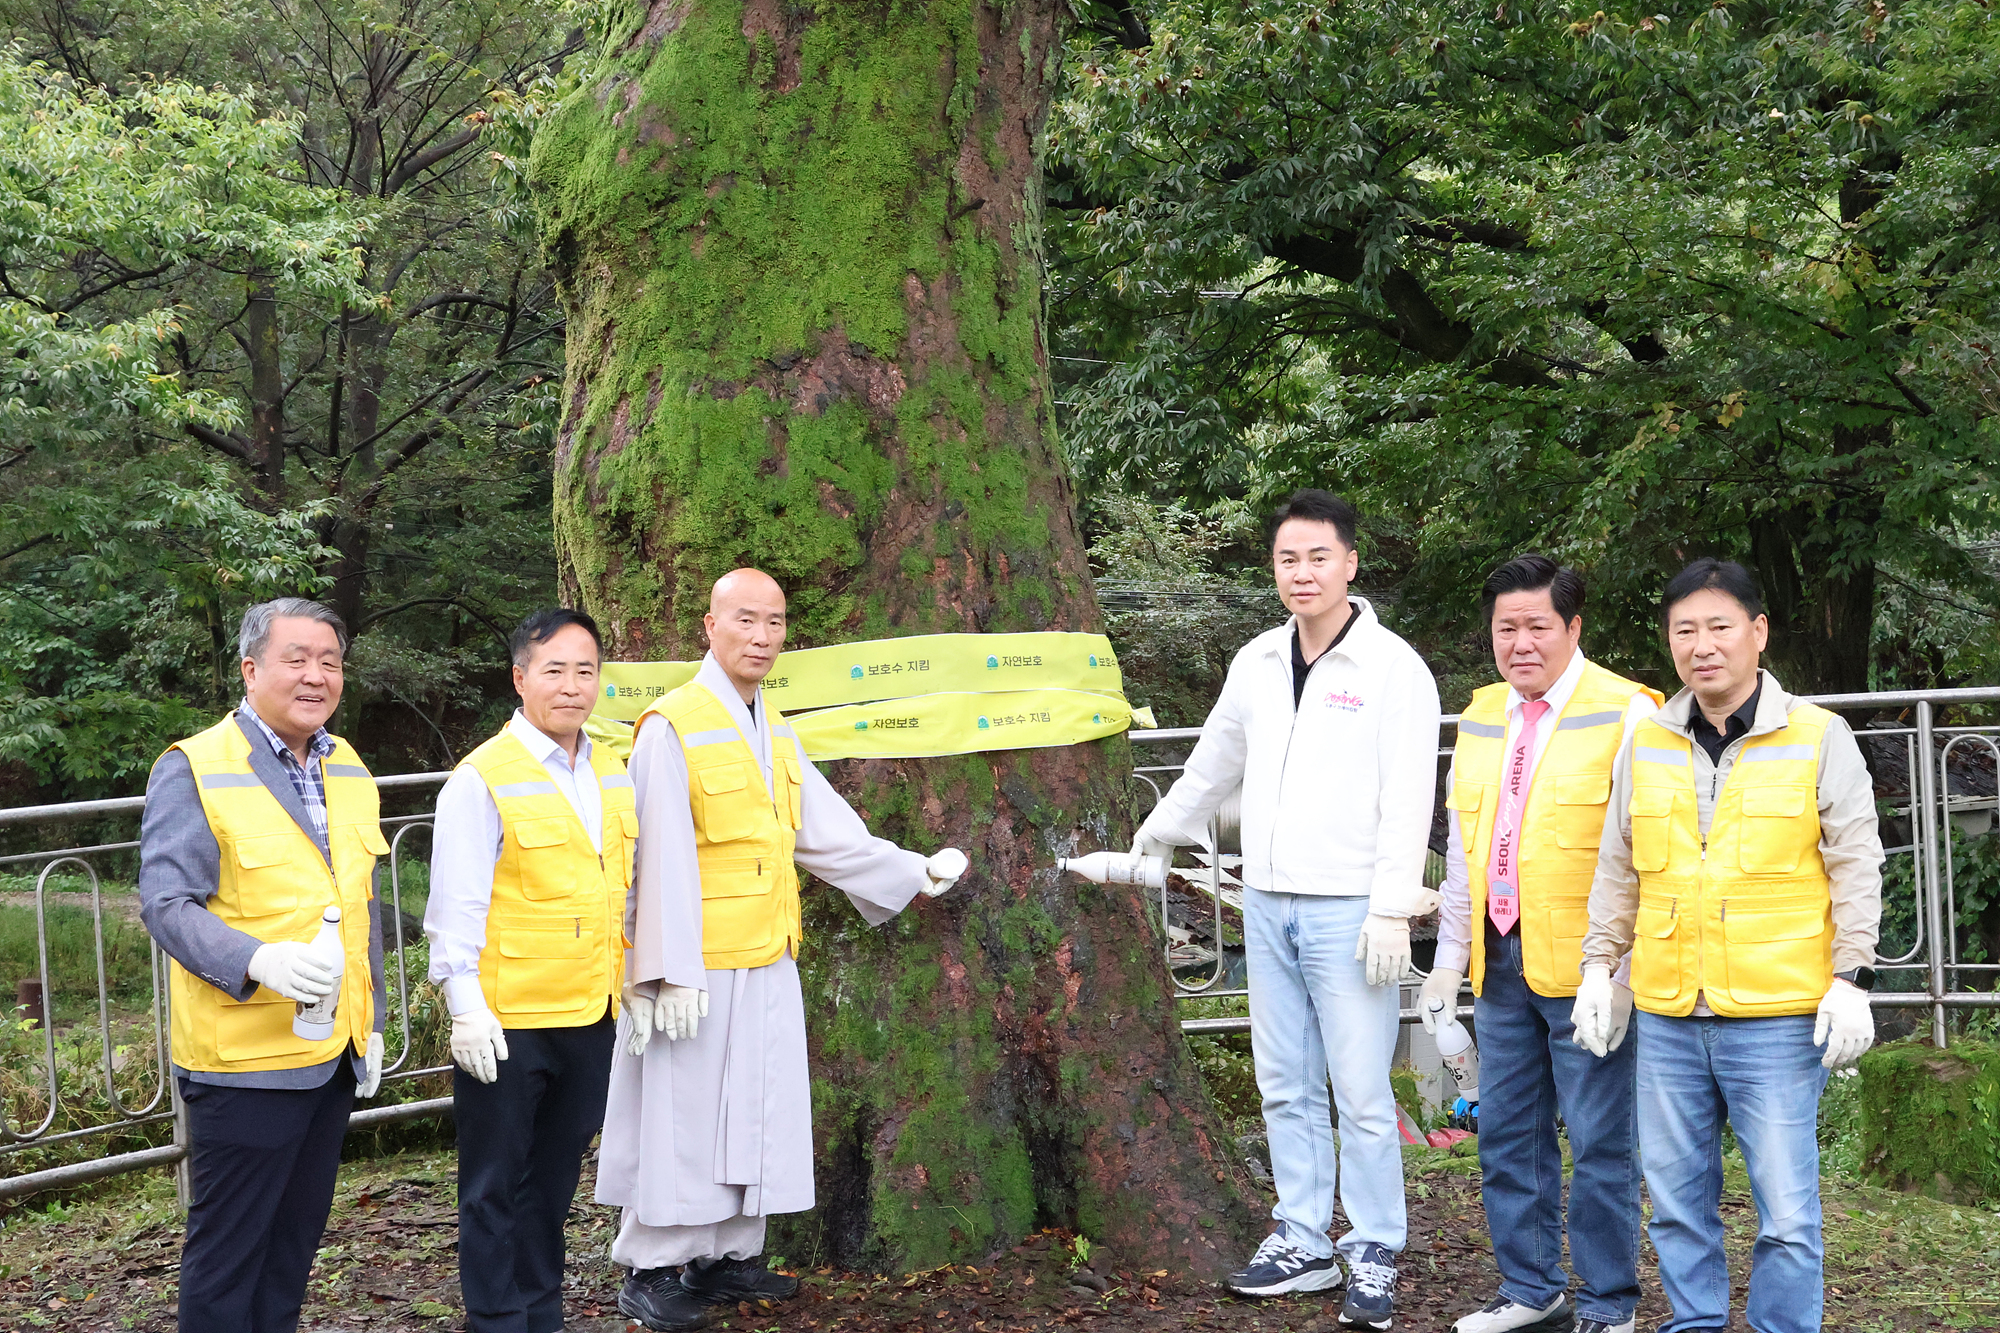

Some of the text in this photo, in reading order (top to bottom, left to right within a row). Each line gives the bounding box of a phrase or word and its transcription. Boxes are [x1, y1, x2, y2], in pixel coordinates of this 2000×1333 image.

[868, 659, 930, 676] 보호수 지킴
[1002, 655, 1042, 667] 자연보호
[759, 677, 789, 690] 연보호
[618, 686, 665, 698] 보호수 지킴
[872, 717, 920, 729] 자연보호
[992, 711, 1051, 728] 보호수 지킴
[1498, 829, 1512, 877] SEOUL
[1510, 745, 1526, 796] ARENA
